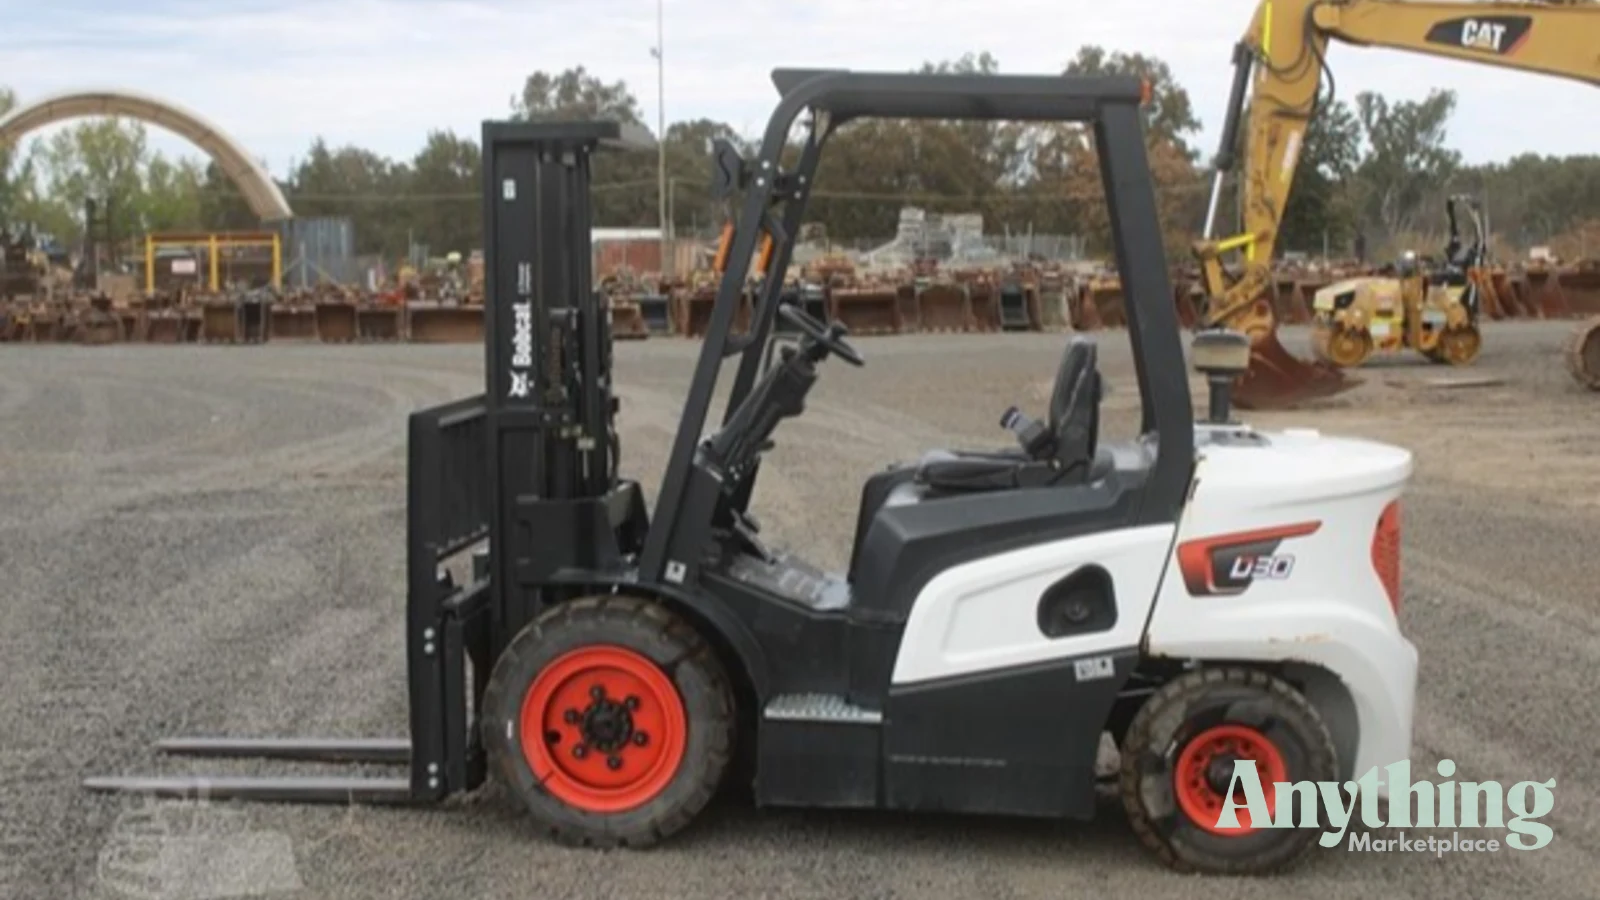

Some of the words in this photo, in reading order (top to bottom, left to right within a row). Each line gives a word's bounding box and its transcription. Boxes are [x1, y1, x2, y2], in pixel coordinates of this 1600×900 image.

[1461, 19, 1506, 51] CAT
[512, 302, 532, 366] Bobcat
[1229, 555, 1295, 580] D30
